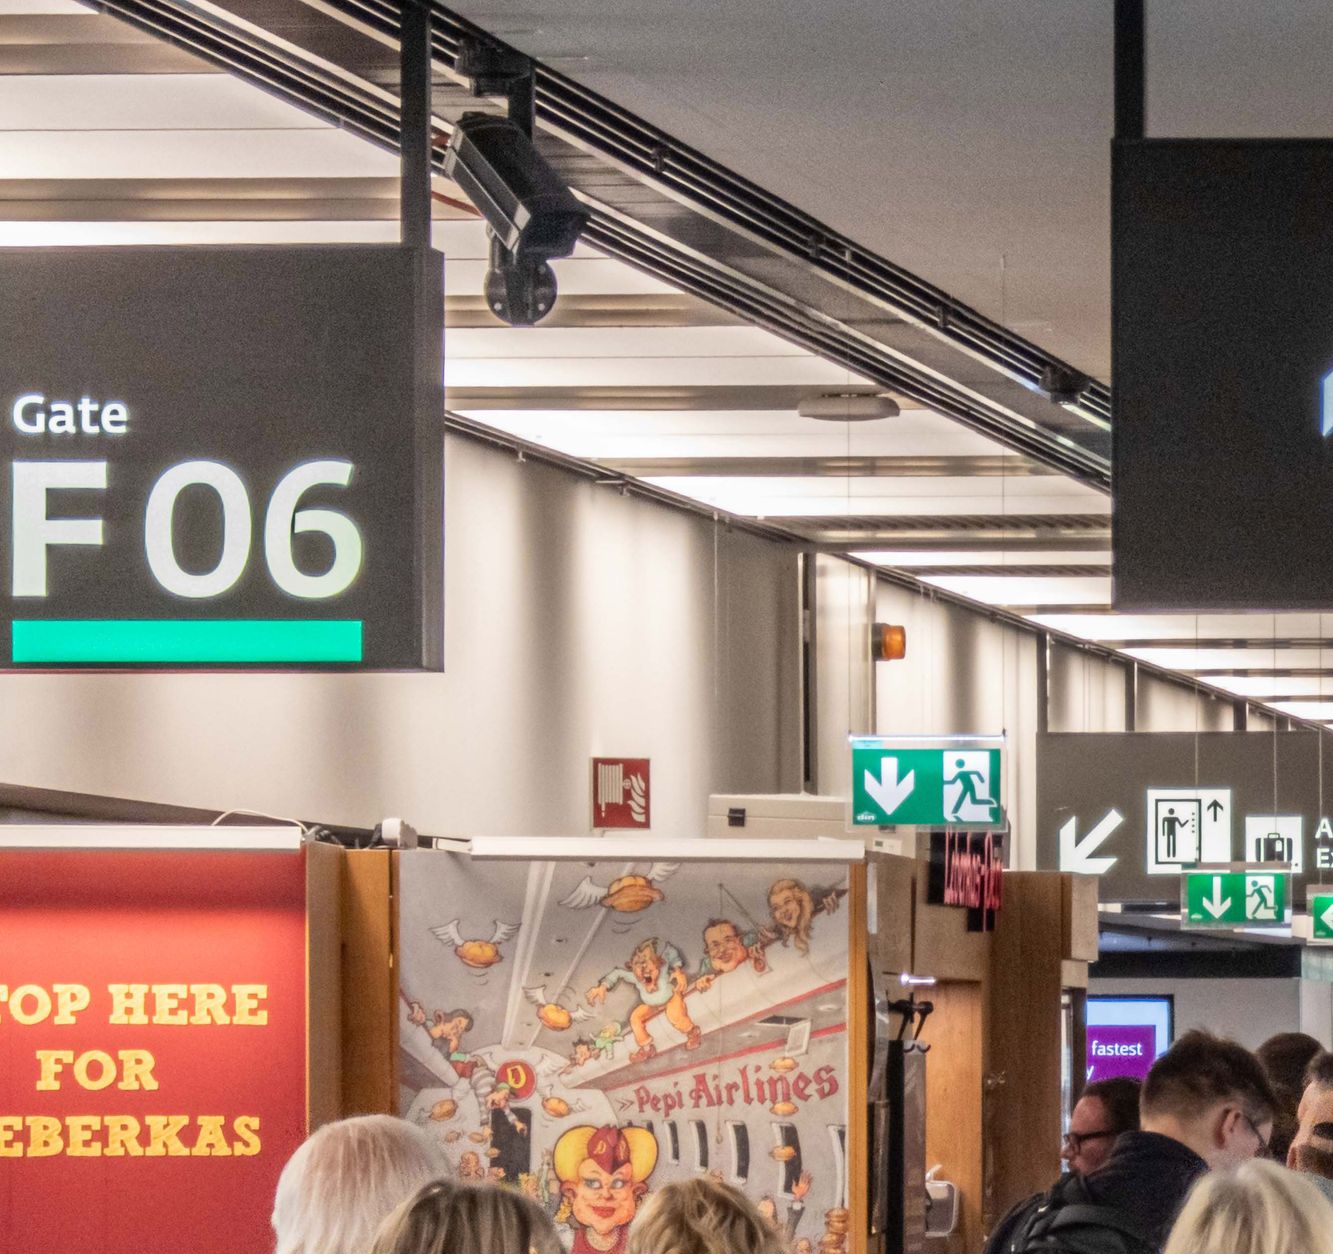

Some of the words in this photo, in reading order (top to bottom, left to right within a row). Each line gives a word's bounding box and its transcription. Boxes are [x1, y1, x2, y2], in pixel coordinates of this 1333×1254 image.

[12, 393, 129, 435] Gate
[12, 460, 108, 598] F
[144, 459, 363, 599] 06
[0, 984, 91, 1025] OP
[107, 983, 268, 1025] HERE
[1091, 1040, 1143, 1056] fastest
[36, 1049, 159, 1091] FOR
[633, 1081, 685, 1118] Pepi
[689, 1063, 840, 1109] Airlines
[0, 1115, 262, 1158] EBERKAS
